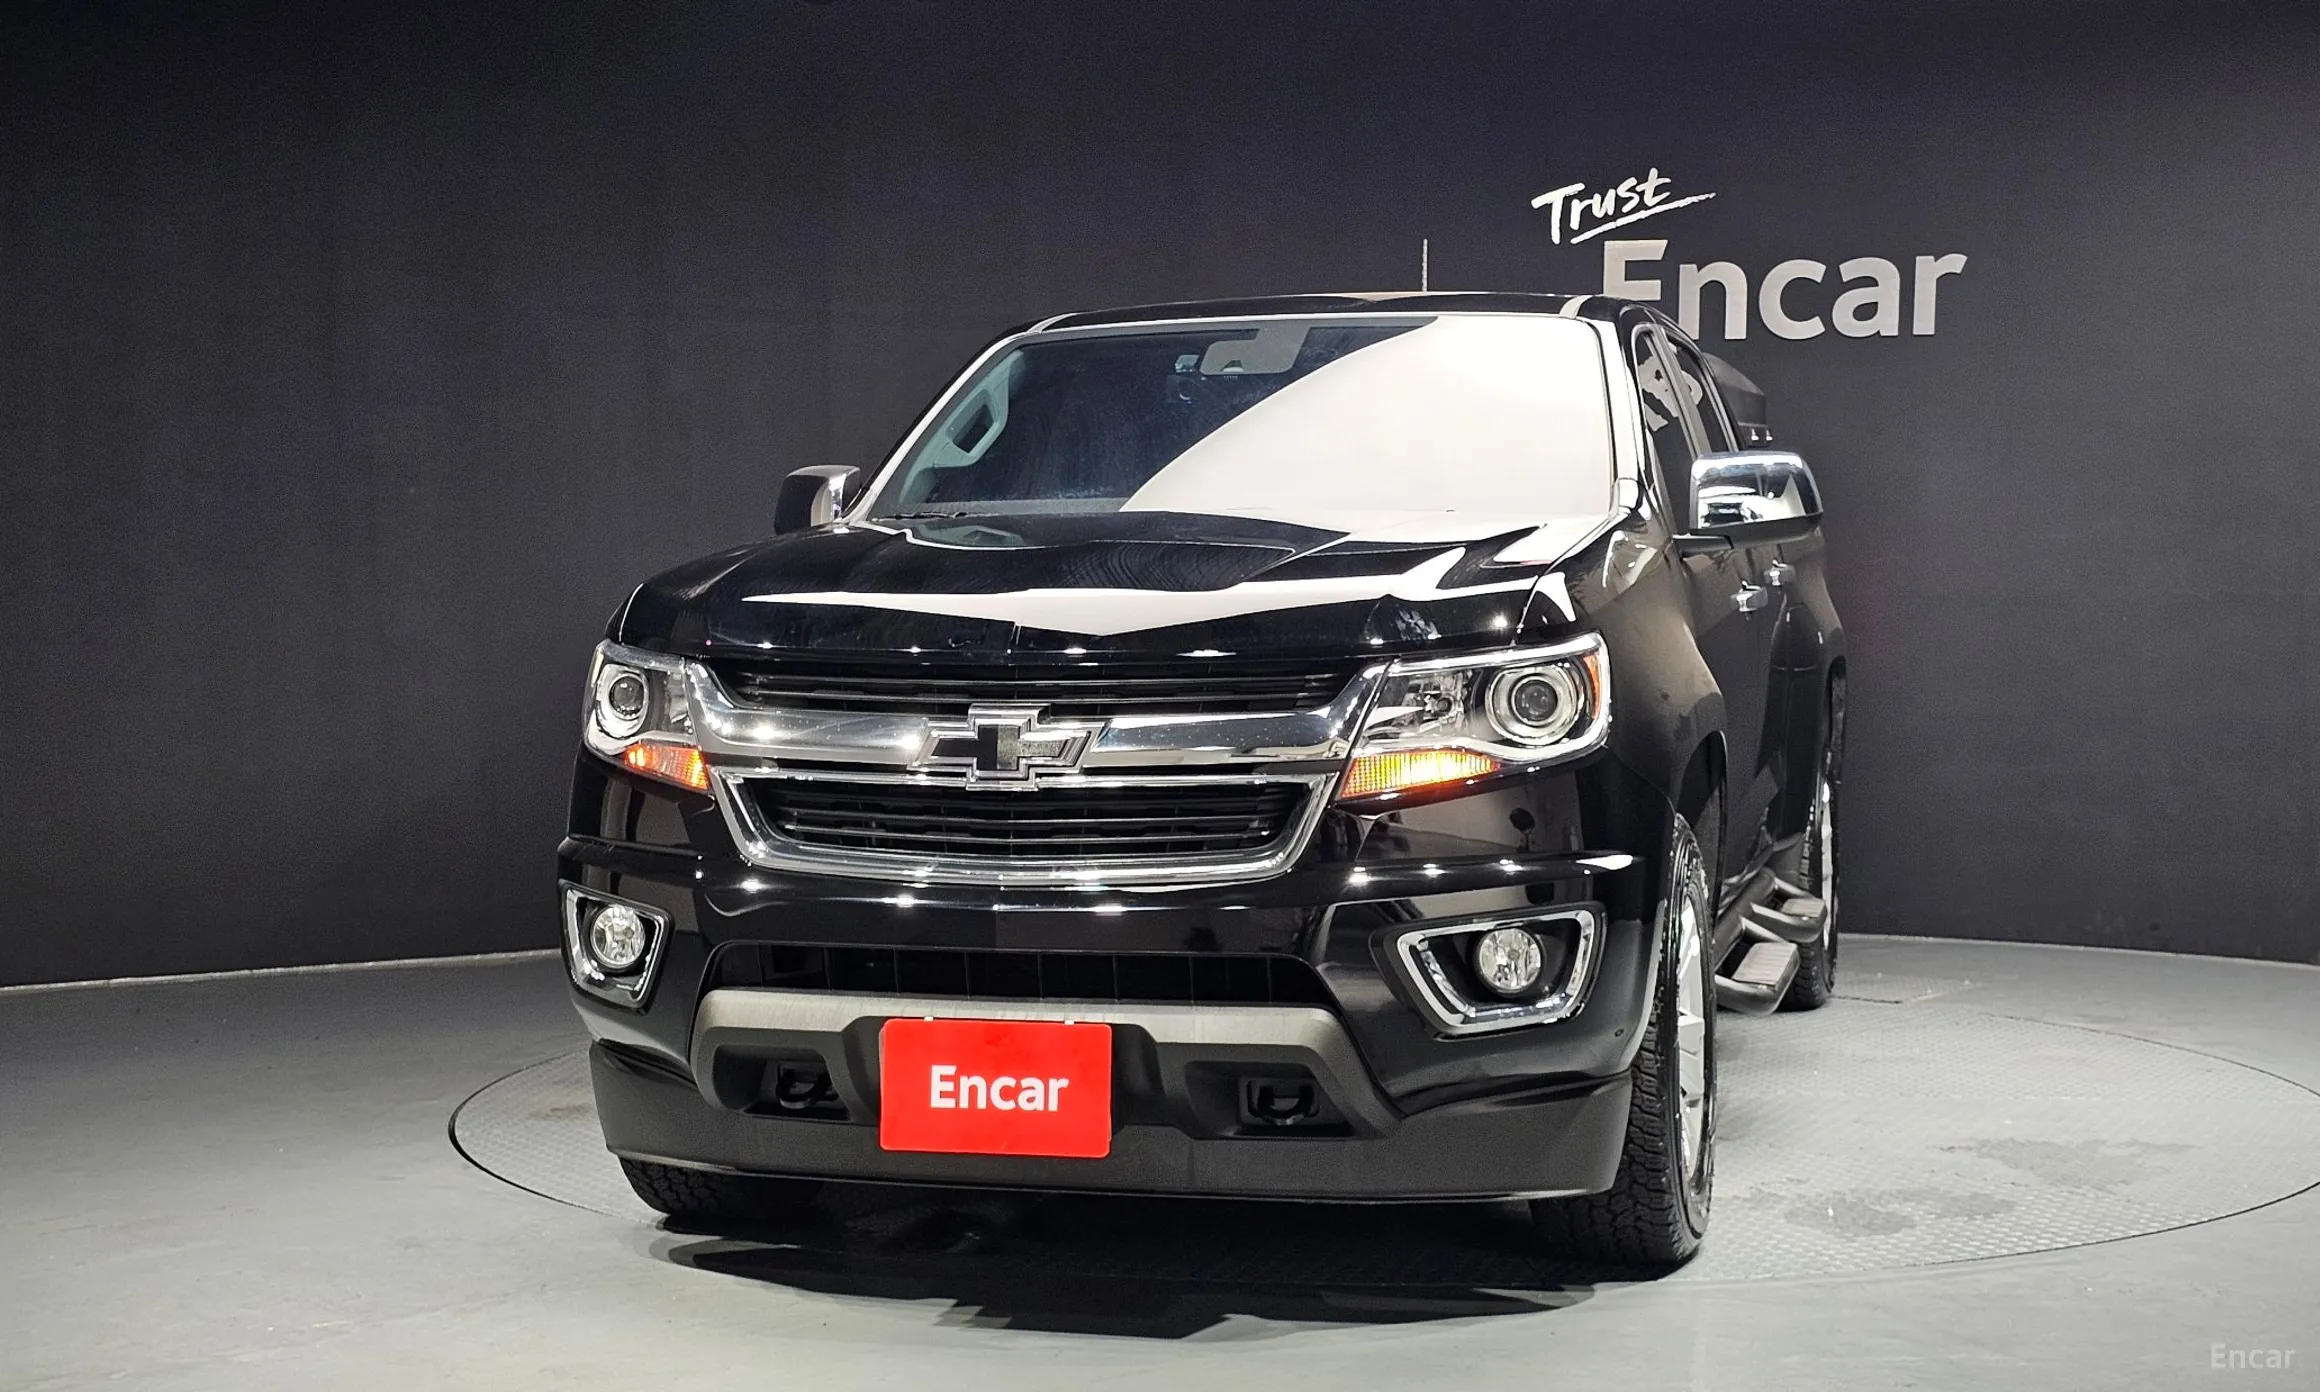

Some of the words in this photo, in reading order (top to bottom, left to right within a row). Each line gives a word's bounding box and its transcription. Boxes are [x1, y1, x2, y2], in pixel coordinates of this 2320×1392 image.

[1531, 167, 1672, 245] Trust
[1603, 239, 1968, 341] Encar
[929, 1064, 1069, 1112] Encar
